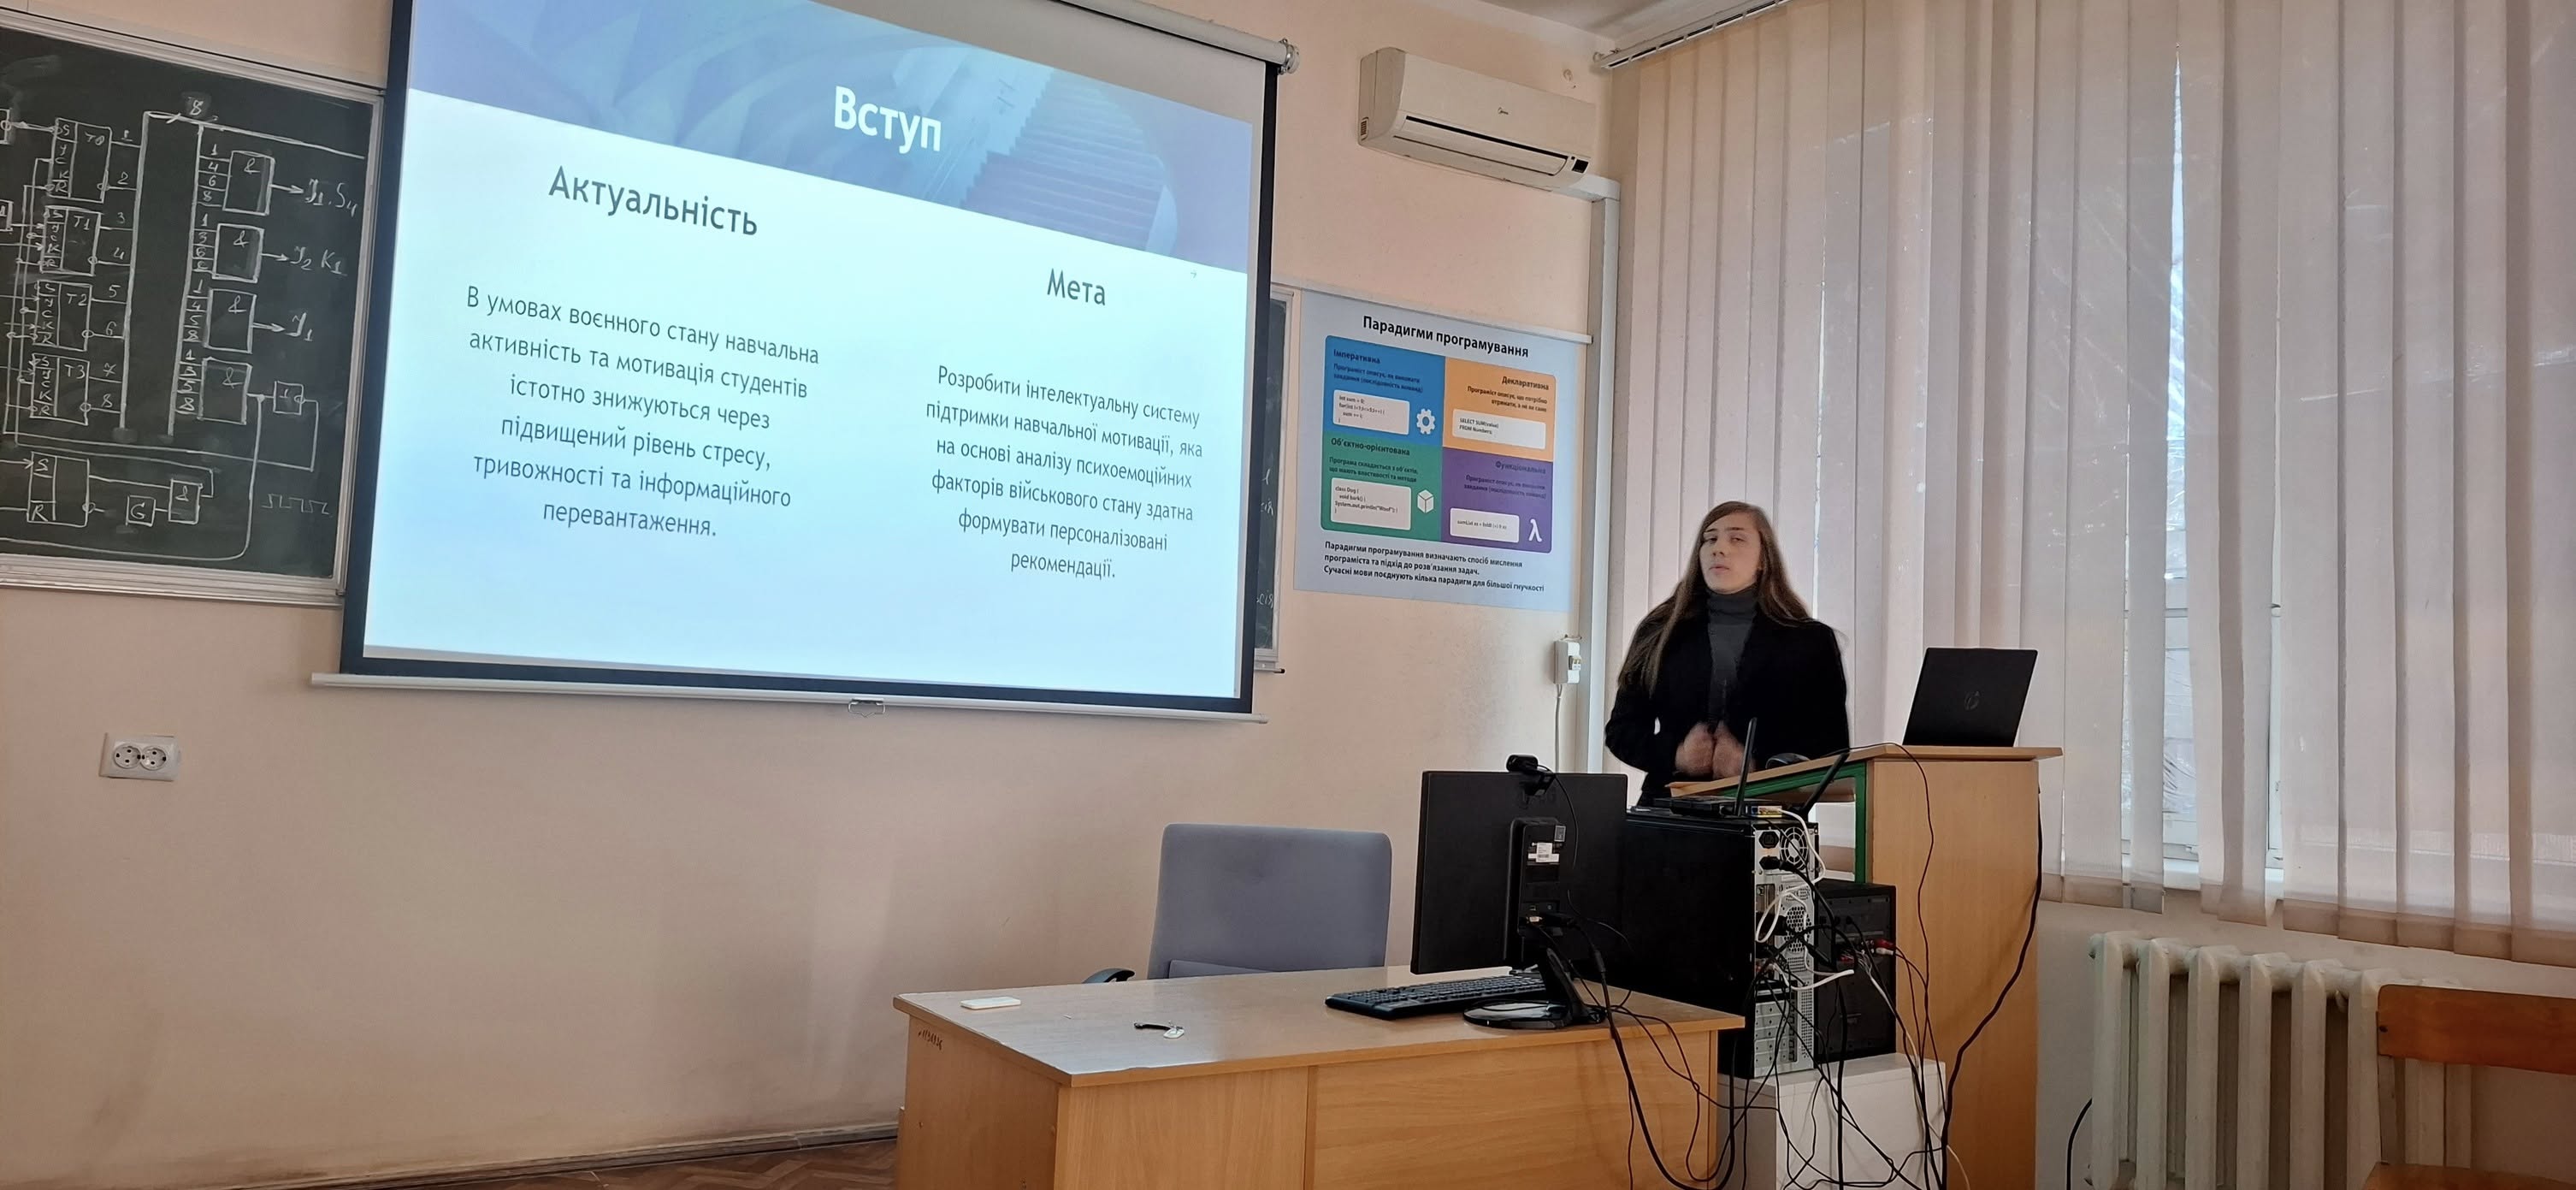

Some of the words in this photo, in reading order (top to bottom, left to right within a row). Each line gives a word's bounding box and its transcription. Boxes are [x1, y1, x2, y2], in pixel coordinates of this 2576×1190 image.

[834, 86, 942, 153] Вступ
[548, 166, 758, 235] Актуальність
[1047, 269, 1105, 305] Мета
[468, 286, 478, 308] В
[487, 293, 561, 322] умовах
[570, 308, 659, 337] воєнного
[668, 324, 718, 351] стану
[726, 335, 818, 364] навчальна
[1363, 316, 1433, 340] Парадигми
[1437, 332, 1528, 358] програмування
[470, 332, 580, 364] активність
[590, 350, 609, 368] та
[617, 356, 713, 384] мотивація
[721, 370, 806, 399] студентів
[1334, 349, 1380, 364] Імперативна
[511, 374, 584, 404] істотно
[593, 390, 709, 421] знижуються
[718, 409, 769, 430] через
[939, 365, 1019, 397] Розробити
[1026, 381, 1138, 419] інтелектуальну
[1143, 403, 1199, 429] систему
[1502, 376, 1549, 390] Декларативна
[502, 416, 625, 450] підвищений
[634, 432, 695, 459] рівень
[703, 444, 770, 471] стресу,
[927, 400, 1008, 429] підтримки
[1015, 416, 1096, 441] навчальної
[1102, 430, 1173, 457] мотивації,
[1180, 442, 1202, 457] яка
[474, 455, 603, 487] тривожності
[612, 470, 630, 489] та
[640, 471, 790, 506] інформаційного
[937, 440, 954, 454] на
[961, 442, 1010, 463] основі
[1017, 450, 1071, 476] аналізу
[1077, 459, 1191, 488] психоемоційних
[932, 469, 1003, 500] факторів
[1010, 479, 1097, 508] військового
[1103, 496, 1141, 519] стану
[1147, 503, 1192, 521] здатна
[544, 503, 716, 536] перевантаження.
[960, 508, 1044, 536] формувати
[1051, 524, 1167, 550] персоналізовані
[1012, 553, 1115, 580] рекомендації.
[1324, 554, 1369, 566] програміста
[1380, 559, 1402, 569] підхід
[1414, 563, 1456, 573] розв'язання
[1325, 541, 1367, 554] Парадигми
[1368, 547, 1424, 559] програмування
[1426, 553, 1466, 563] визначають
[1468, 557, 1488, 565] спосіб
[1490, 559, 1522, 568] мислення
[1324, 565, 1351, 576] Сучасні
[1374, 571, 1413, 582] поєднують
[1415, 574, 1437, 583] кілька
[1439, 577, 1471, 588] парадигм
[1486, 579, 1512, 589] більшої
[1514, 583, 1544, 593] гнучкості
